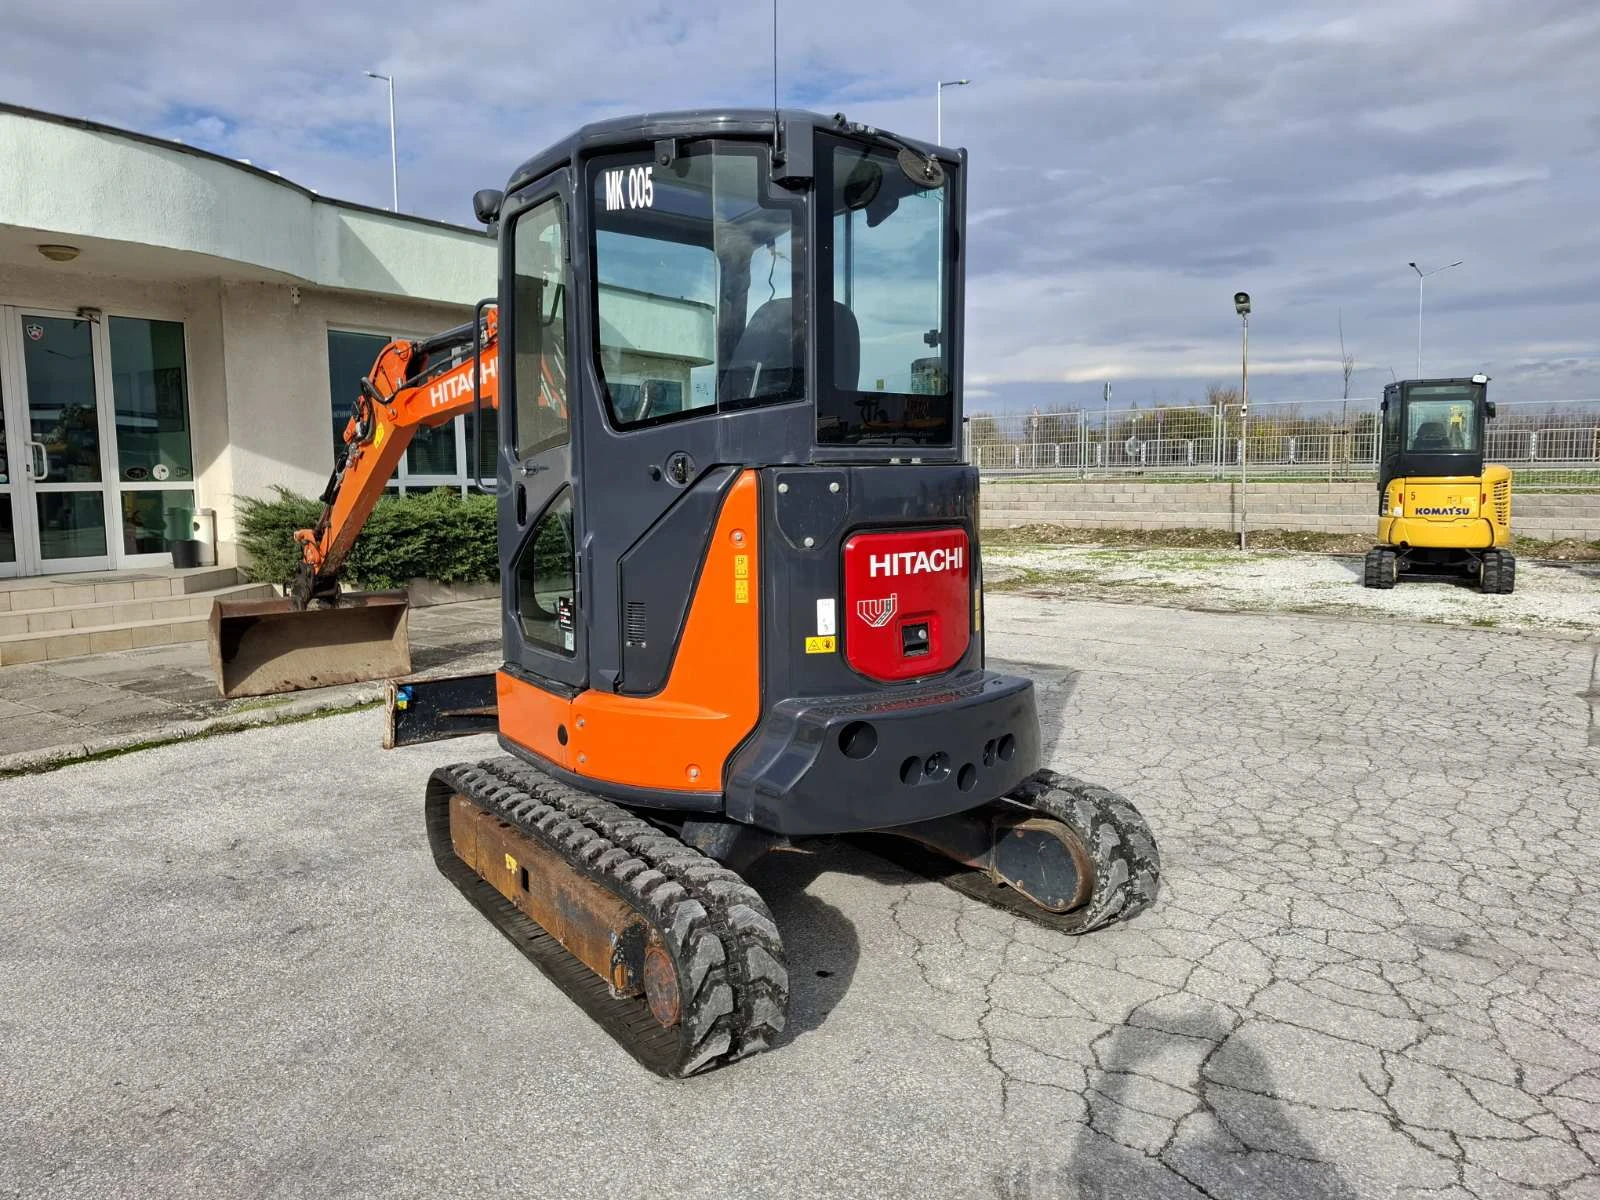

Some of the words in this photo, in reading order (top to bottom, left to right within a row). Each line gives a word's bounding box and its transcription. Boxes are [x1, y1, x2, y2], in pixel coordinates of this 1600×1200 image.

[605, 170, 625, 211] MK
[628, 166, 654, 209] 005
[1415, 506, 1470, 516] KOMATSU
[869, 546, 963, 578] HITACHI
